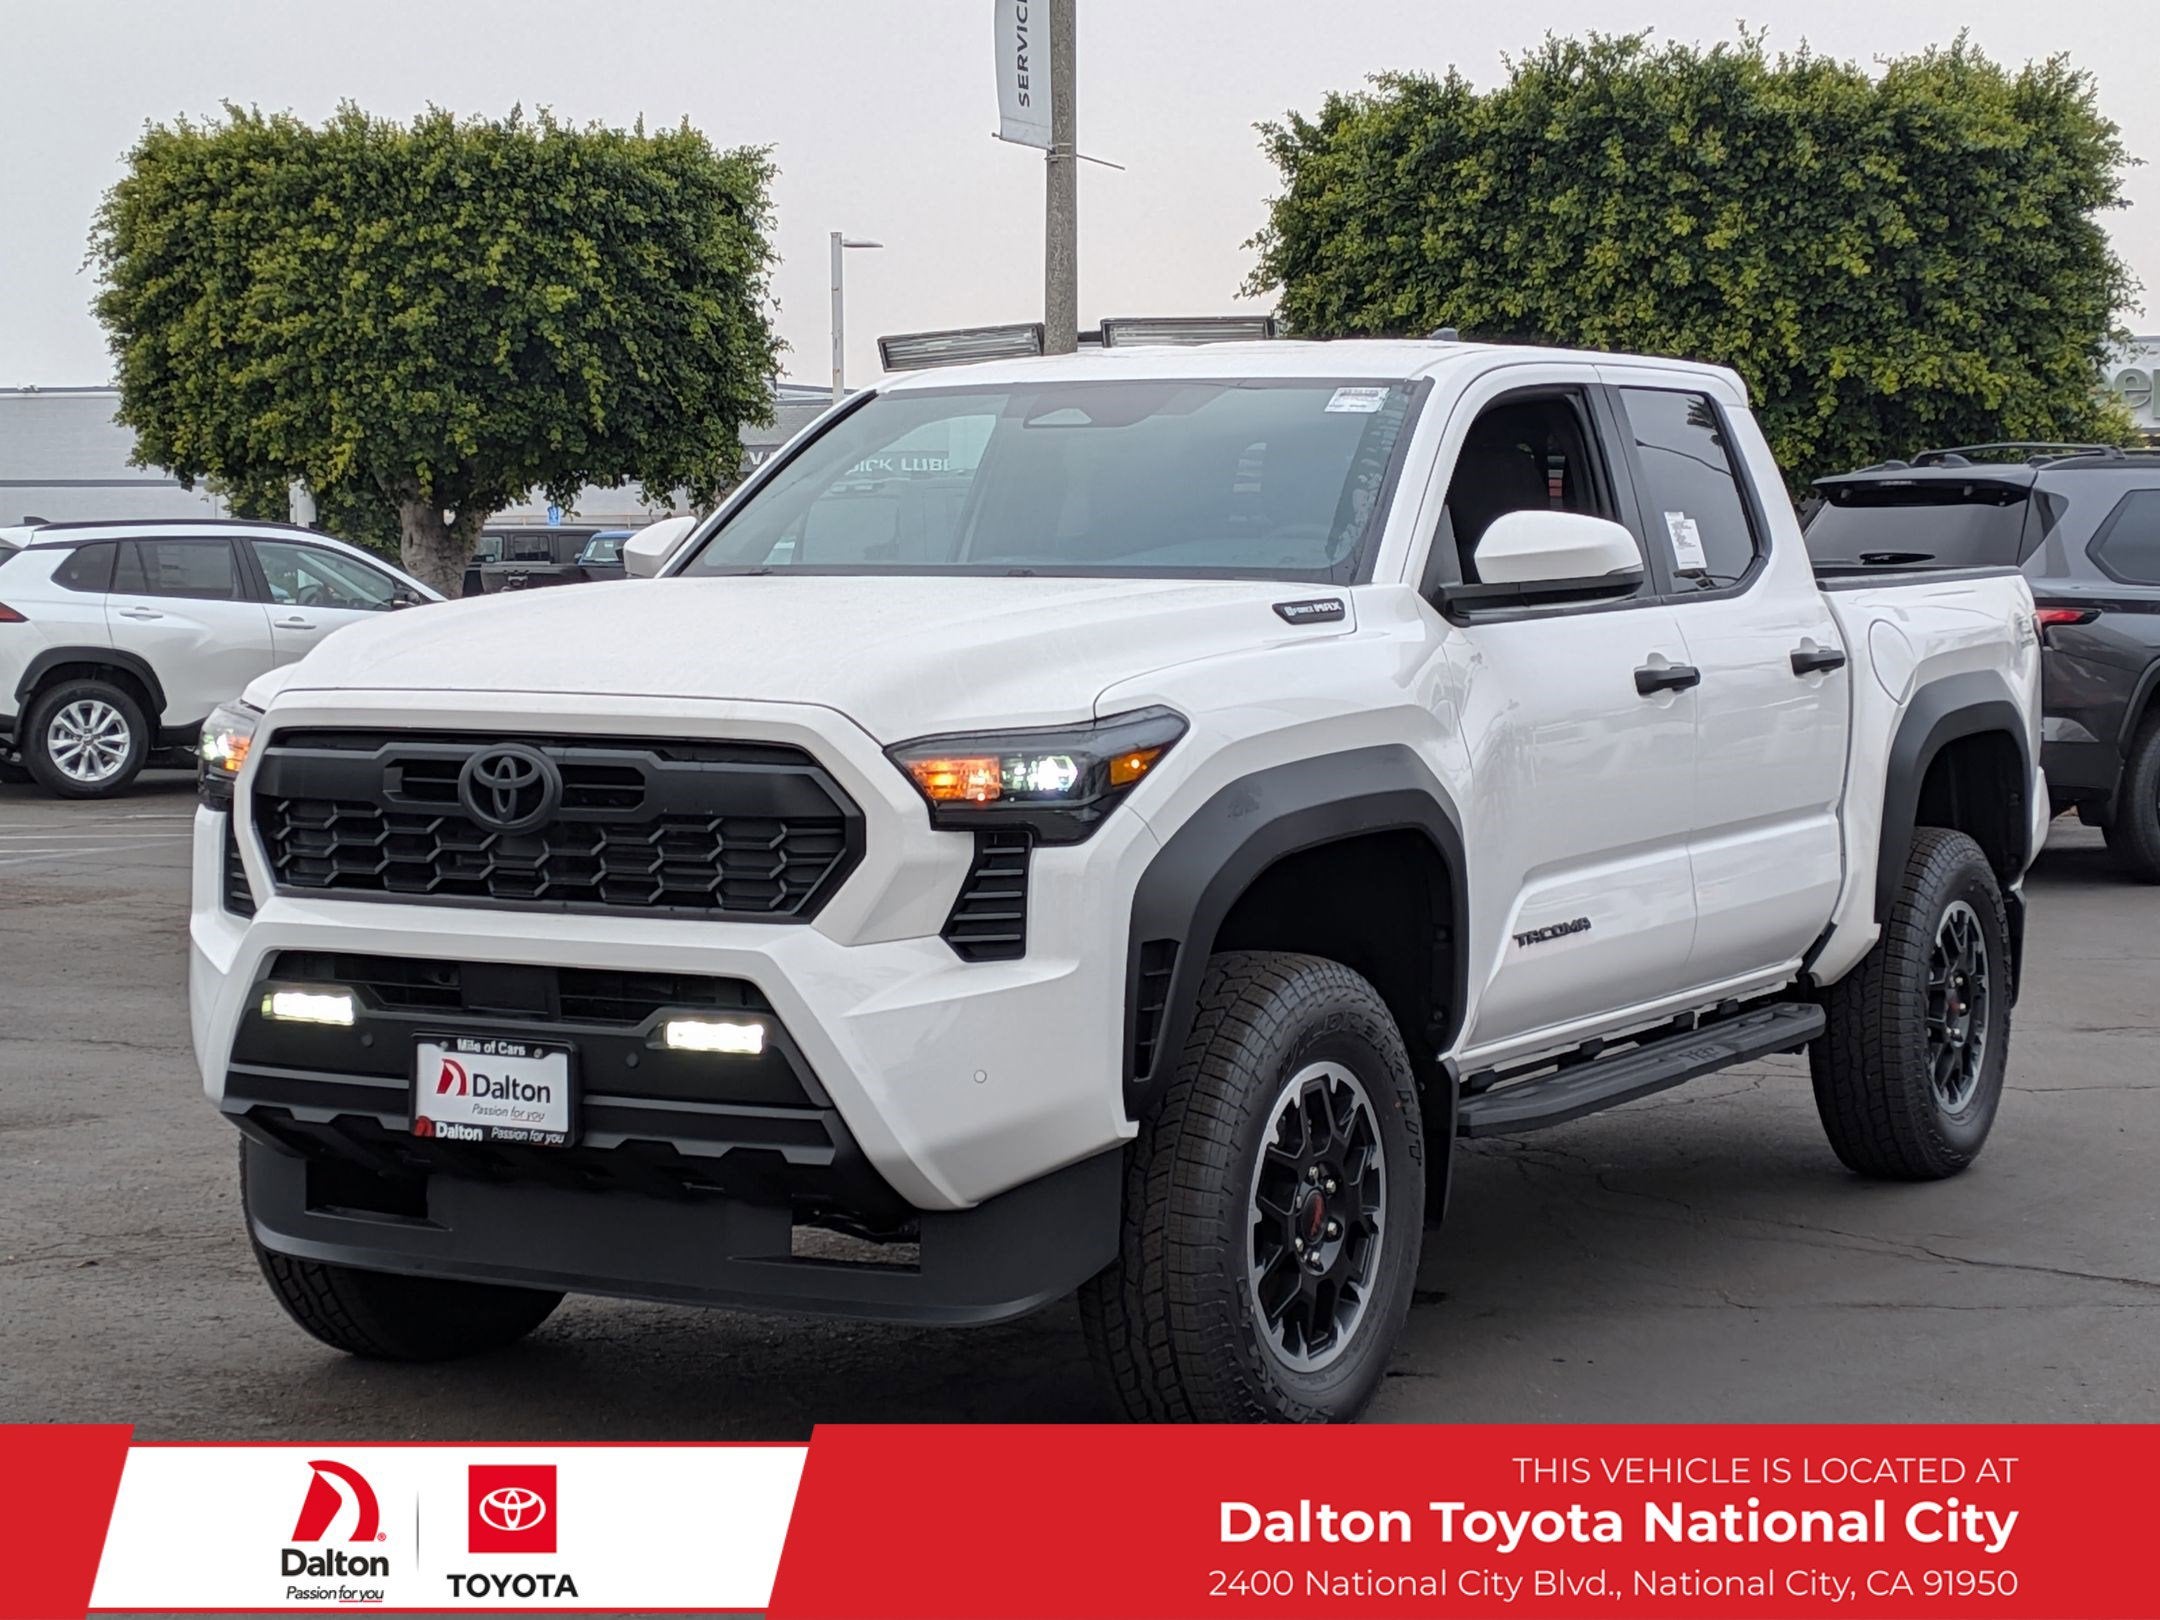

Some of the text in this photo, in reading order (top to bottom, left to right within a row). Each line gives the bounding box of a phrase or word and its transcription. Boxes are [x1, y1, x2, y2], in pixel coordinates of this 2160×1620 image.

[1016, 0, 1030, 108] SERVIC
[1512, 916, 1592, 949] TACOMA
[457, 1038, 526, 1057] Mile of Cars
[473, 1073, 551, 1104] Dalton
[471, 1103, 546, 1122] Passion for you
[435, 1122, 566, 1145] Dalton Passion for you
